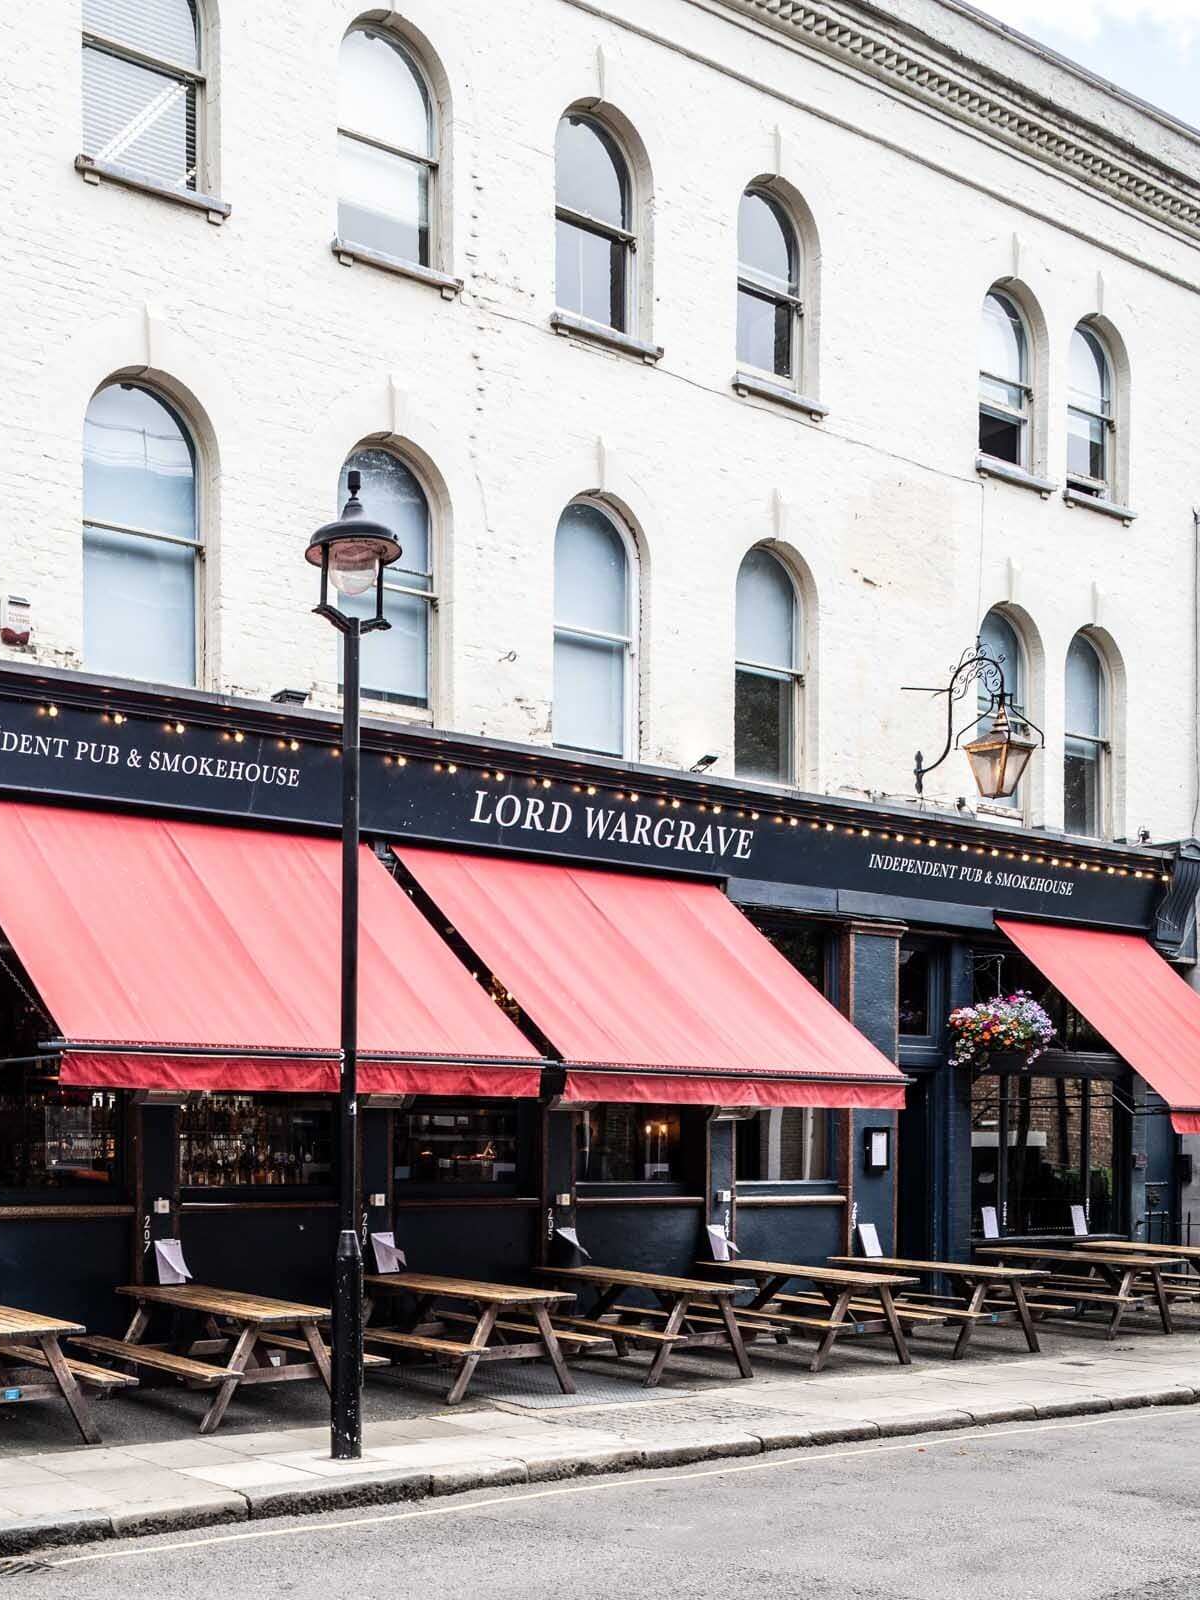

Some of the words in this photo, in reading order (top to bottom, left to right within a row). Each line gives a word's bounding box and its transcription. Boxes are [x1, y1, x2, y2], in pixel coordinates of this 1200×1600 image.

[74, 740, 120, 765] PUB
[126, 748, 142, 768] &
[149, 750, 300, 787] SMOKEHOUSE
[469, 790, 572, 834] LORD
[584, 806, 754, 860] WARGRAVE
[868, 853, 960, 879] INDEPENDENT
[959, 866, 983, 884] PUB
[984, 871, 994, 885] &
[995, 871, 1075, 896] SMOKEHOUSE
[143, 1215, 151, 1253] 207
